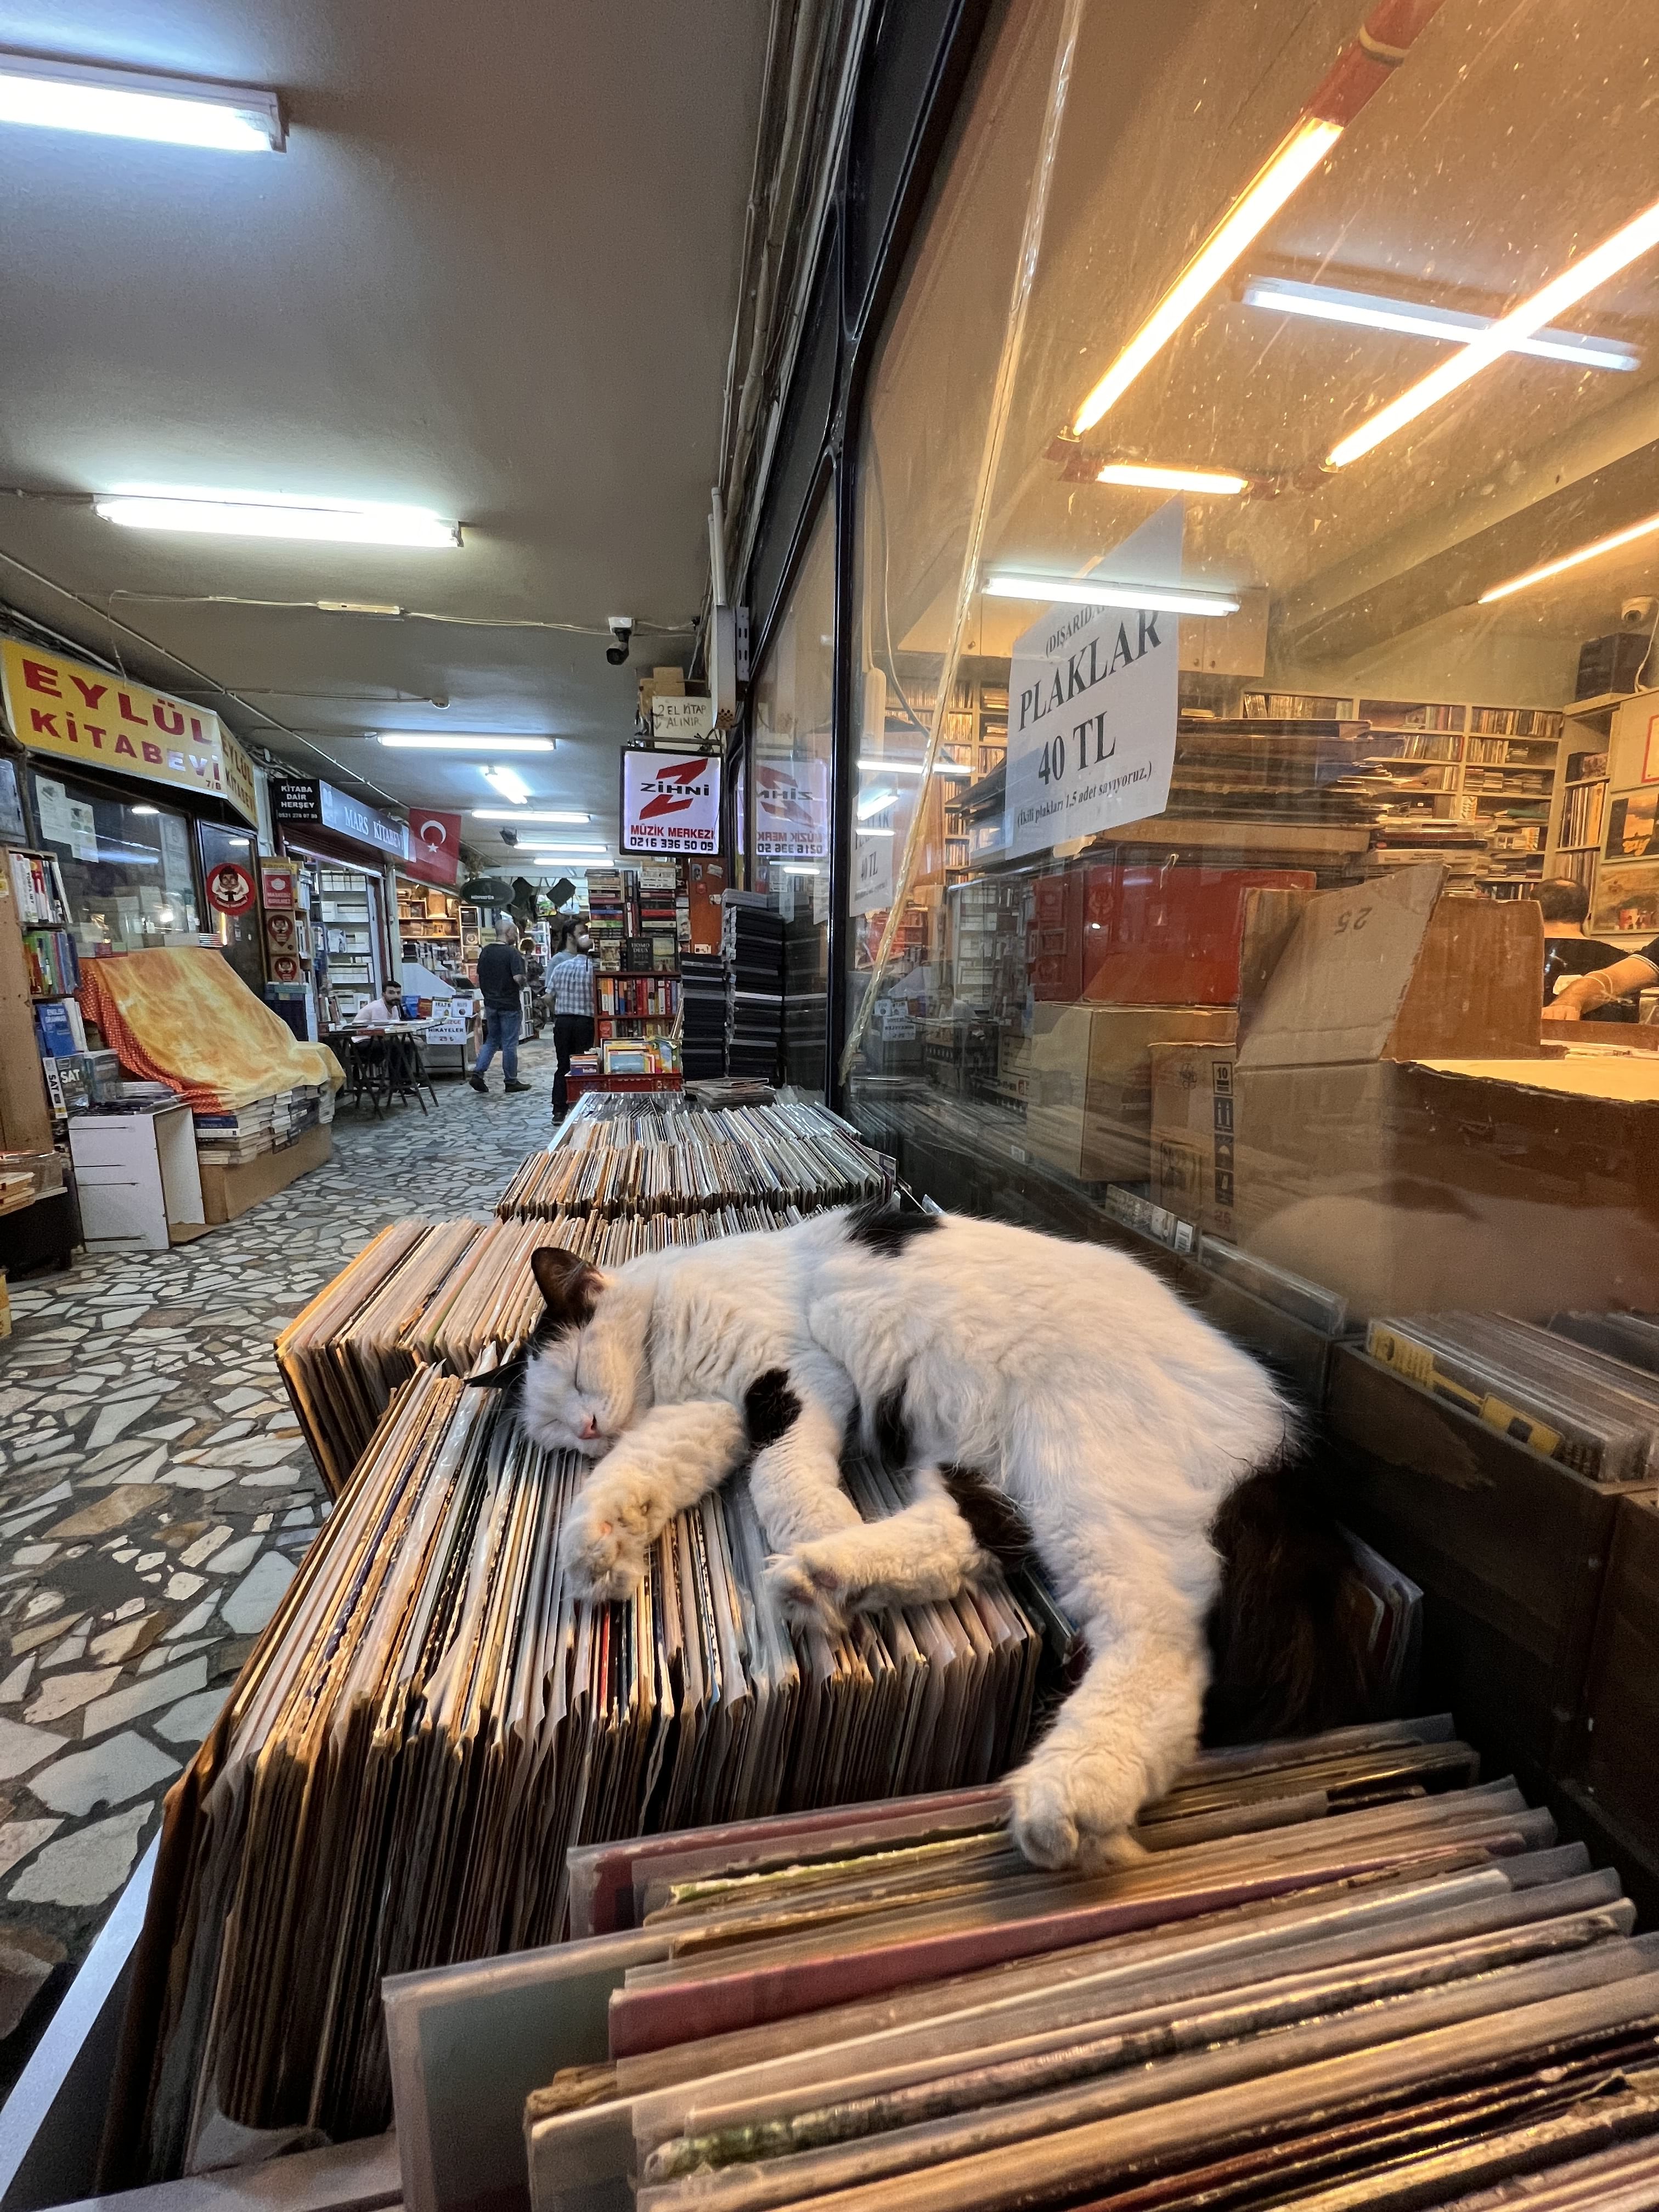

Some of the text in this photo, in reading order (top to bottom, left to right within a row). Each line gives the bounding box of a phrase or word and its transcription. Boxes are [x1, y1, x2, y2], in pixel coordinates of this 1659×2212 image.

[1018, 610, 1162, 732] PLAKLAR
[22, 659, 212, 744] EYLÜL
[667, 706, 680, 715] EL
[666, 716, 702, 729] ALINIR
[30, 708, 220, 781] KİTABEVİ
[1038, 711, 1116, 785] 40 TL
[220, 730, 253, 788] EYLÜL
[281, 785, 313, 793] KİTABA
[1035, 800, 1063, 823] plakları
[1078, 786, 1097, 803] adet
[344, 806, 369, 836] MARS
[631, 823, 714, 839] MÜZİK MERKEZİ
[630, 837, 713, 851] 0216 336 50 09
[48, 1074, 60, 1094] SAT
[60, 1069, 80, 1084] SAT
